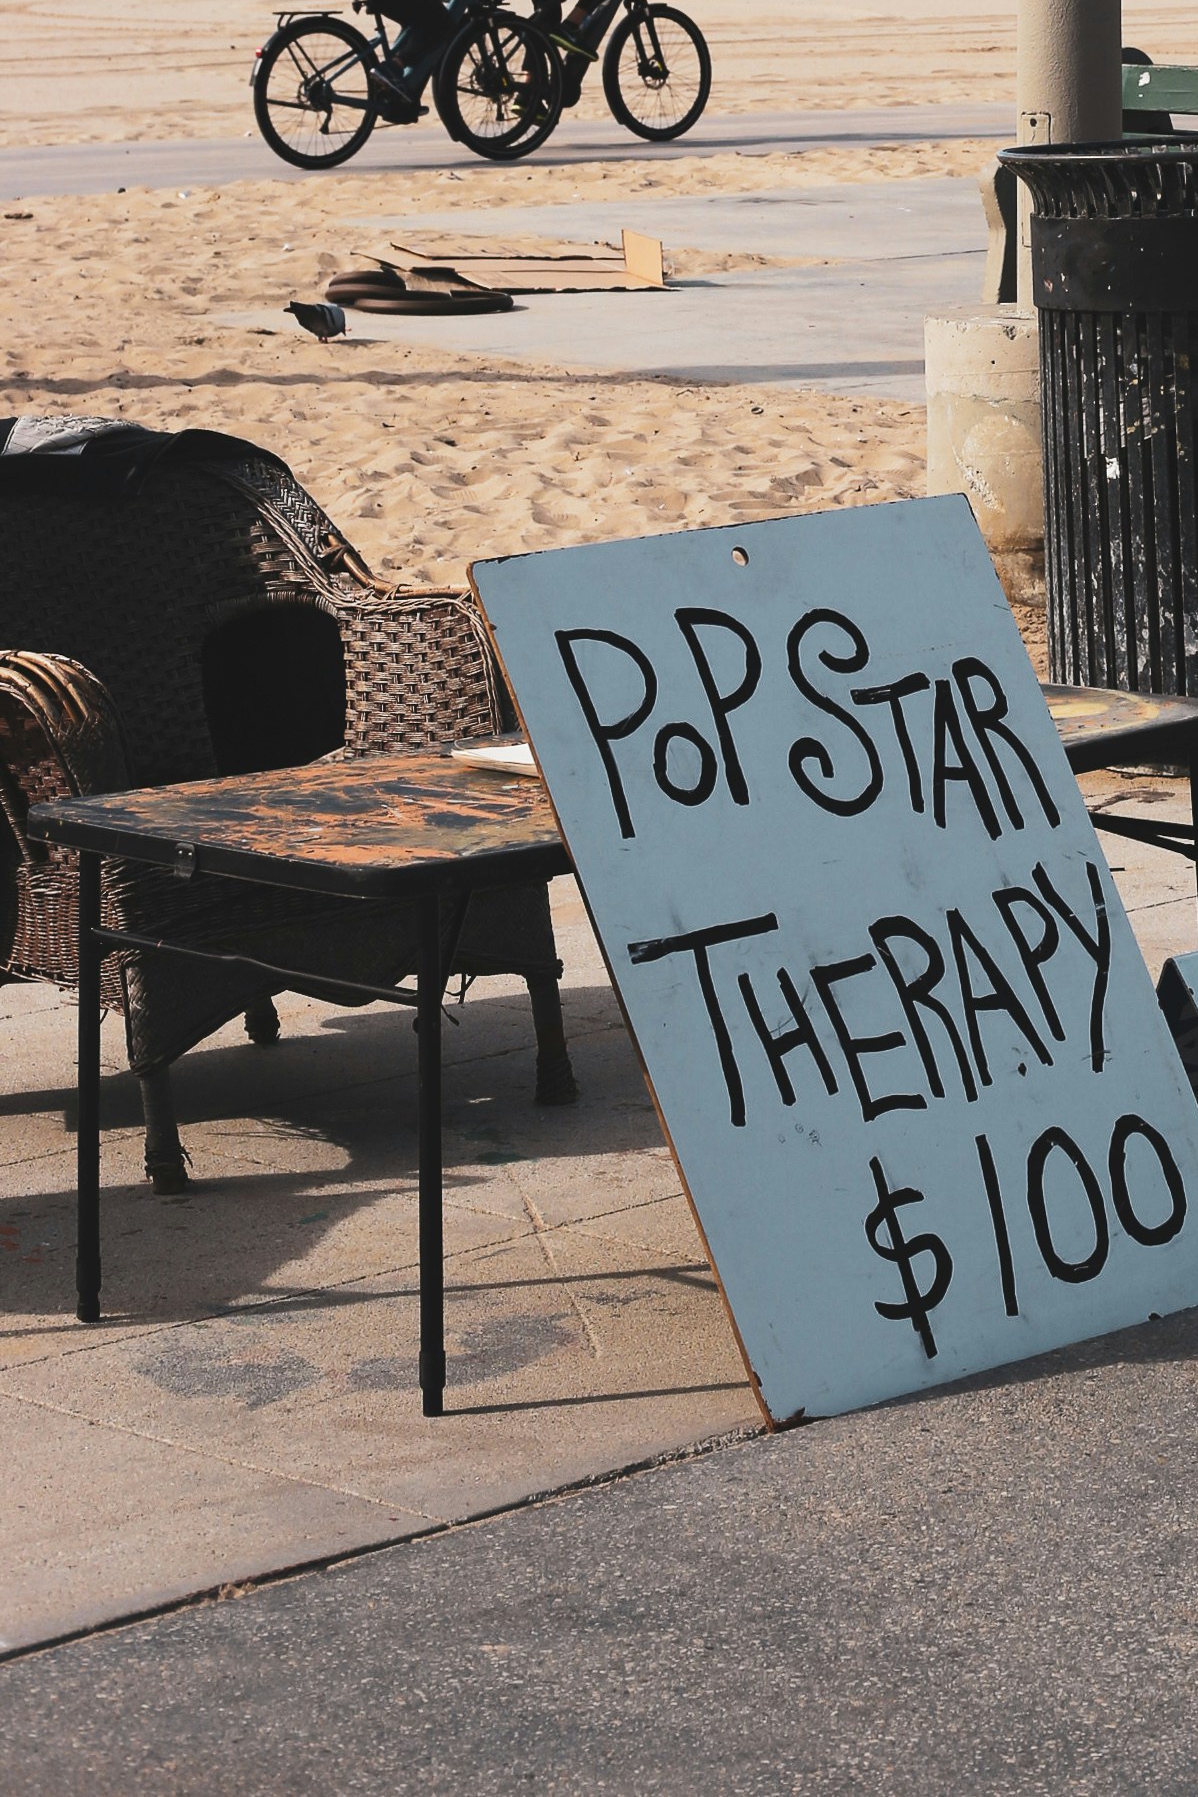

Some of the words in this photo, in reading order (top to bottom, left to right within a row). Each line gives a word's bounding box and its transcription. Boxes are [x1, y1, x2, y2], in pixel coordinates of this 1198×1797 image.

[786, 607, 1061, 840] STAR
[627, 861, 1112, 1128] THERAPY
[864, 1113, 1188, 1359] $100
